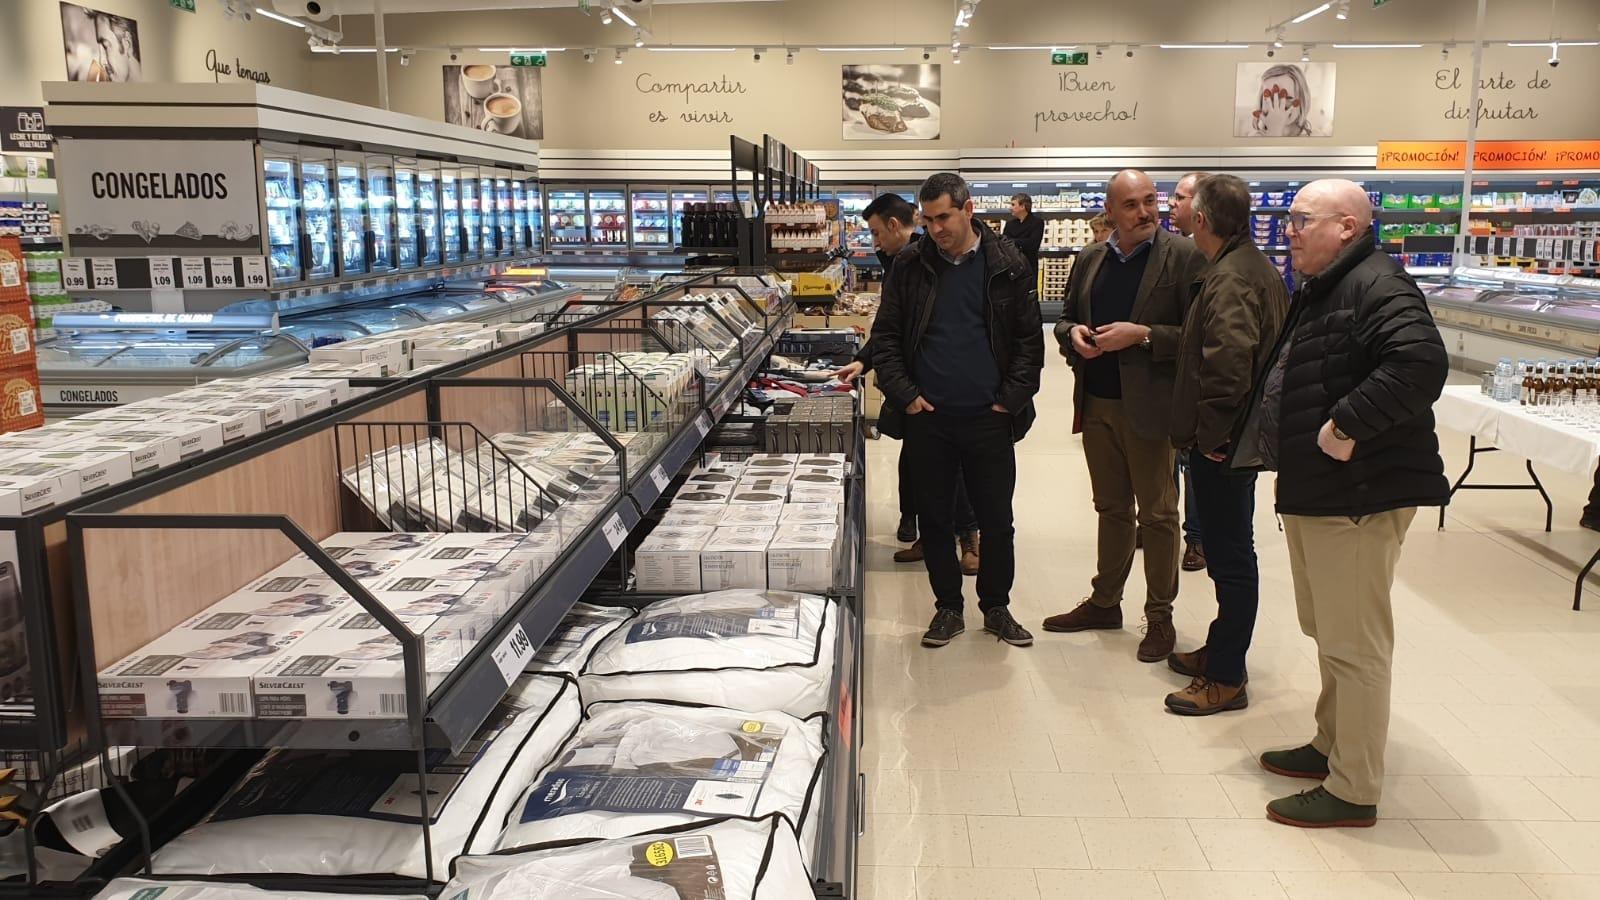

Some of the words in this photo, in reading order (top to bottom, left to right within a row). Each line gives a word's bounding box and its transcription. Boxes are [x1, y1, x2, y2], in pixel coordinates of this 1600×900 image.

[205, 49, 231, 83] Que
[235, 57, 271, 83] tengas
[1435, 67, 1461, 90] El
[1527, 69, 1551, 90] de
[635, 72, 747, 104] Compartir
[648, 110, 668, 122] es
[680, 111, 733, 123] vivir
[1034, 100, 1138, 133] provecho!
[1381, 149, 1459, 162] ¡PROMOCIÓN!
[1473, 148, 1547, 162] PROMOCIÓN!
[1556, 151, 1600, 162] ¡PROMO
[91, 171, 229, 200] CONGELADOS
[66, 277, 85, 286] 0.99
[96, 277, 115, 286] 2.25
[154, 276, 171, 286] 1.09
[187, 275, 203, 285] 1.09
[215, 275, 233, 285] 0.99
[247, 274, 264, 284] 1.99
[60, 390, 118, 402] CONGELADOS
[510, 629, 529, 659] 11.99
[259, 681, 305, 690] SILVERCREST
